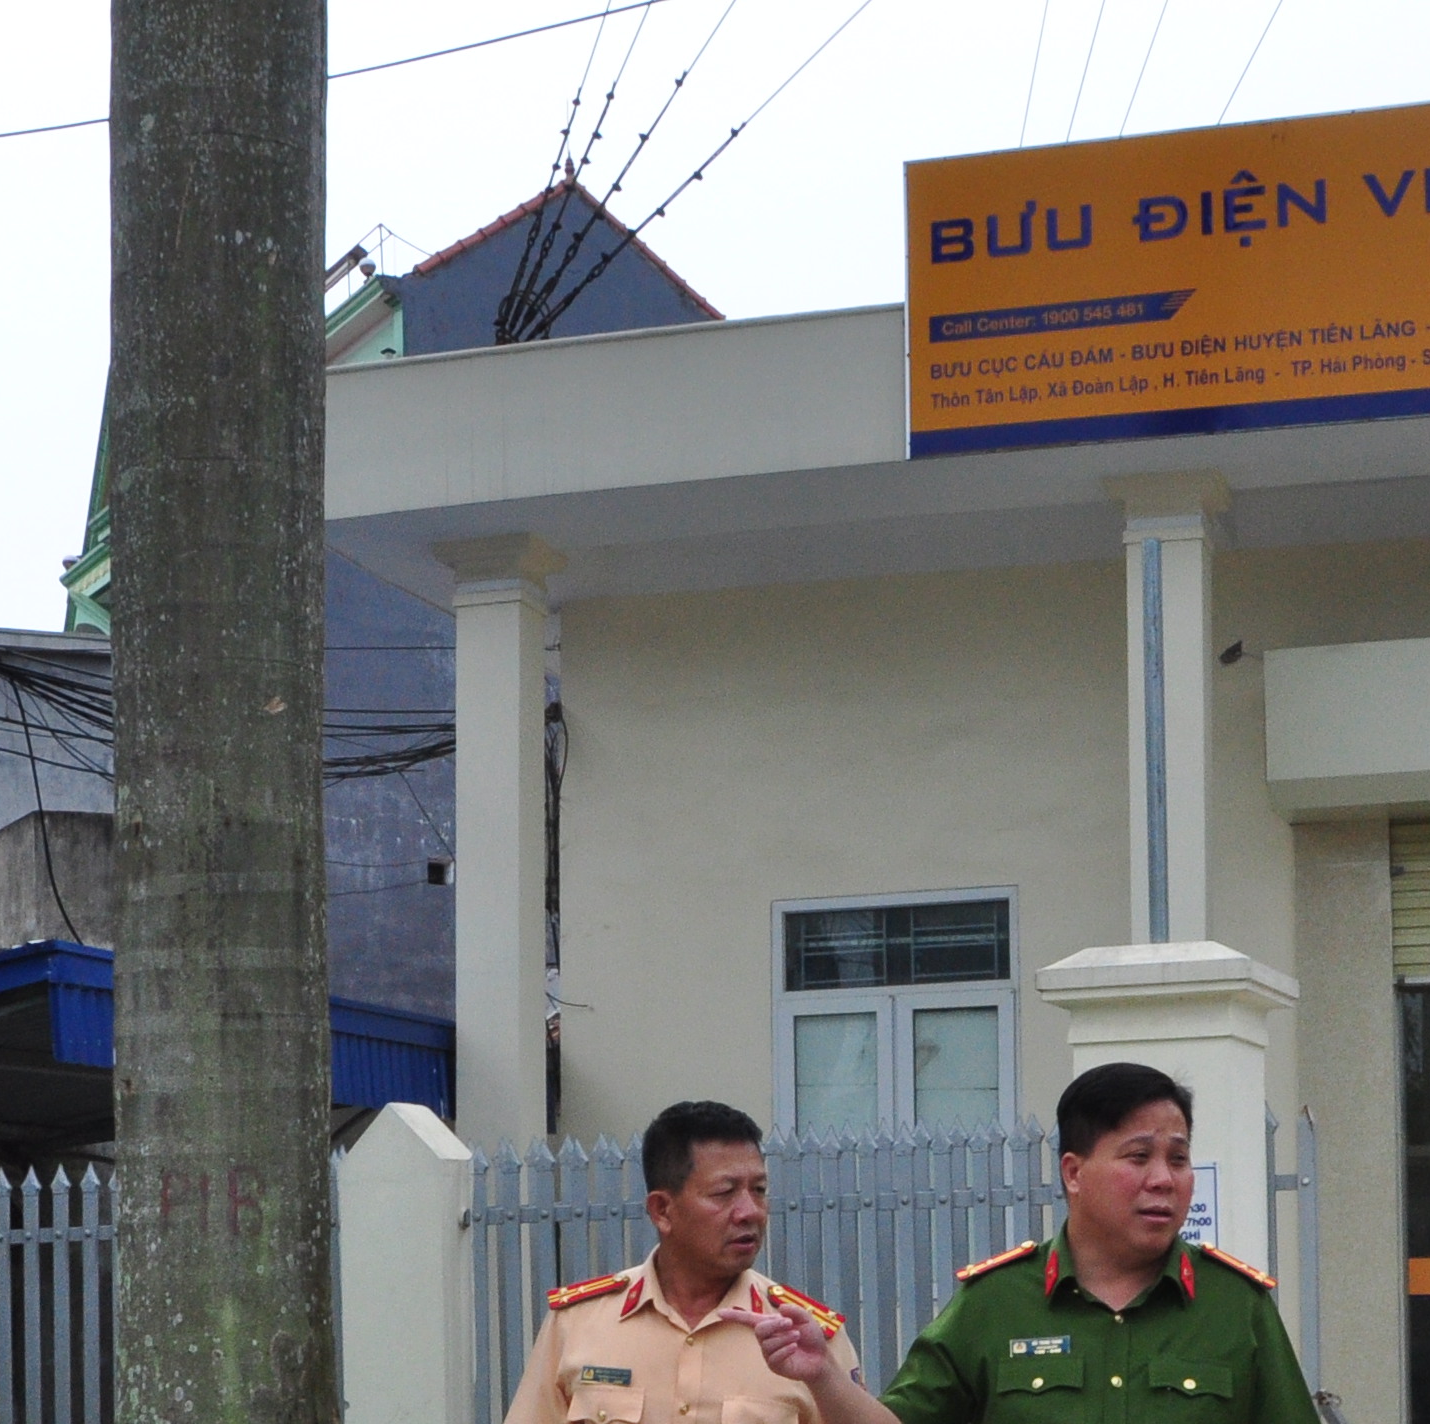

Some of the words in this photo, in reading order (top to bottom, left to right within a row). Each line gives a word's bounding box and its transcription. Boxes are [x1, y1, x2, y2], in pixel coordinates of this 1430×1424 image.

[931, 200, 1092, 265] BƯU
[1132, 169, 1327, 248] ĐIỆN
[942, 319, 971, 335] Call
[1042, 308, 1079, 324] 1900
[931, 361, 972, 379] BƯU
[979, 355, 1018, 378] CỤC
[1132, 342, 1174, 360] BƯU
[1181, 334, 1226, 358] ĐIỆN
[1234, 330, 1302, 351] HUYỆN
